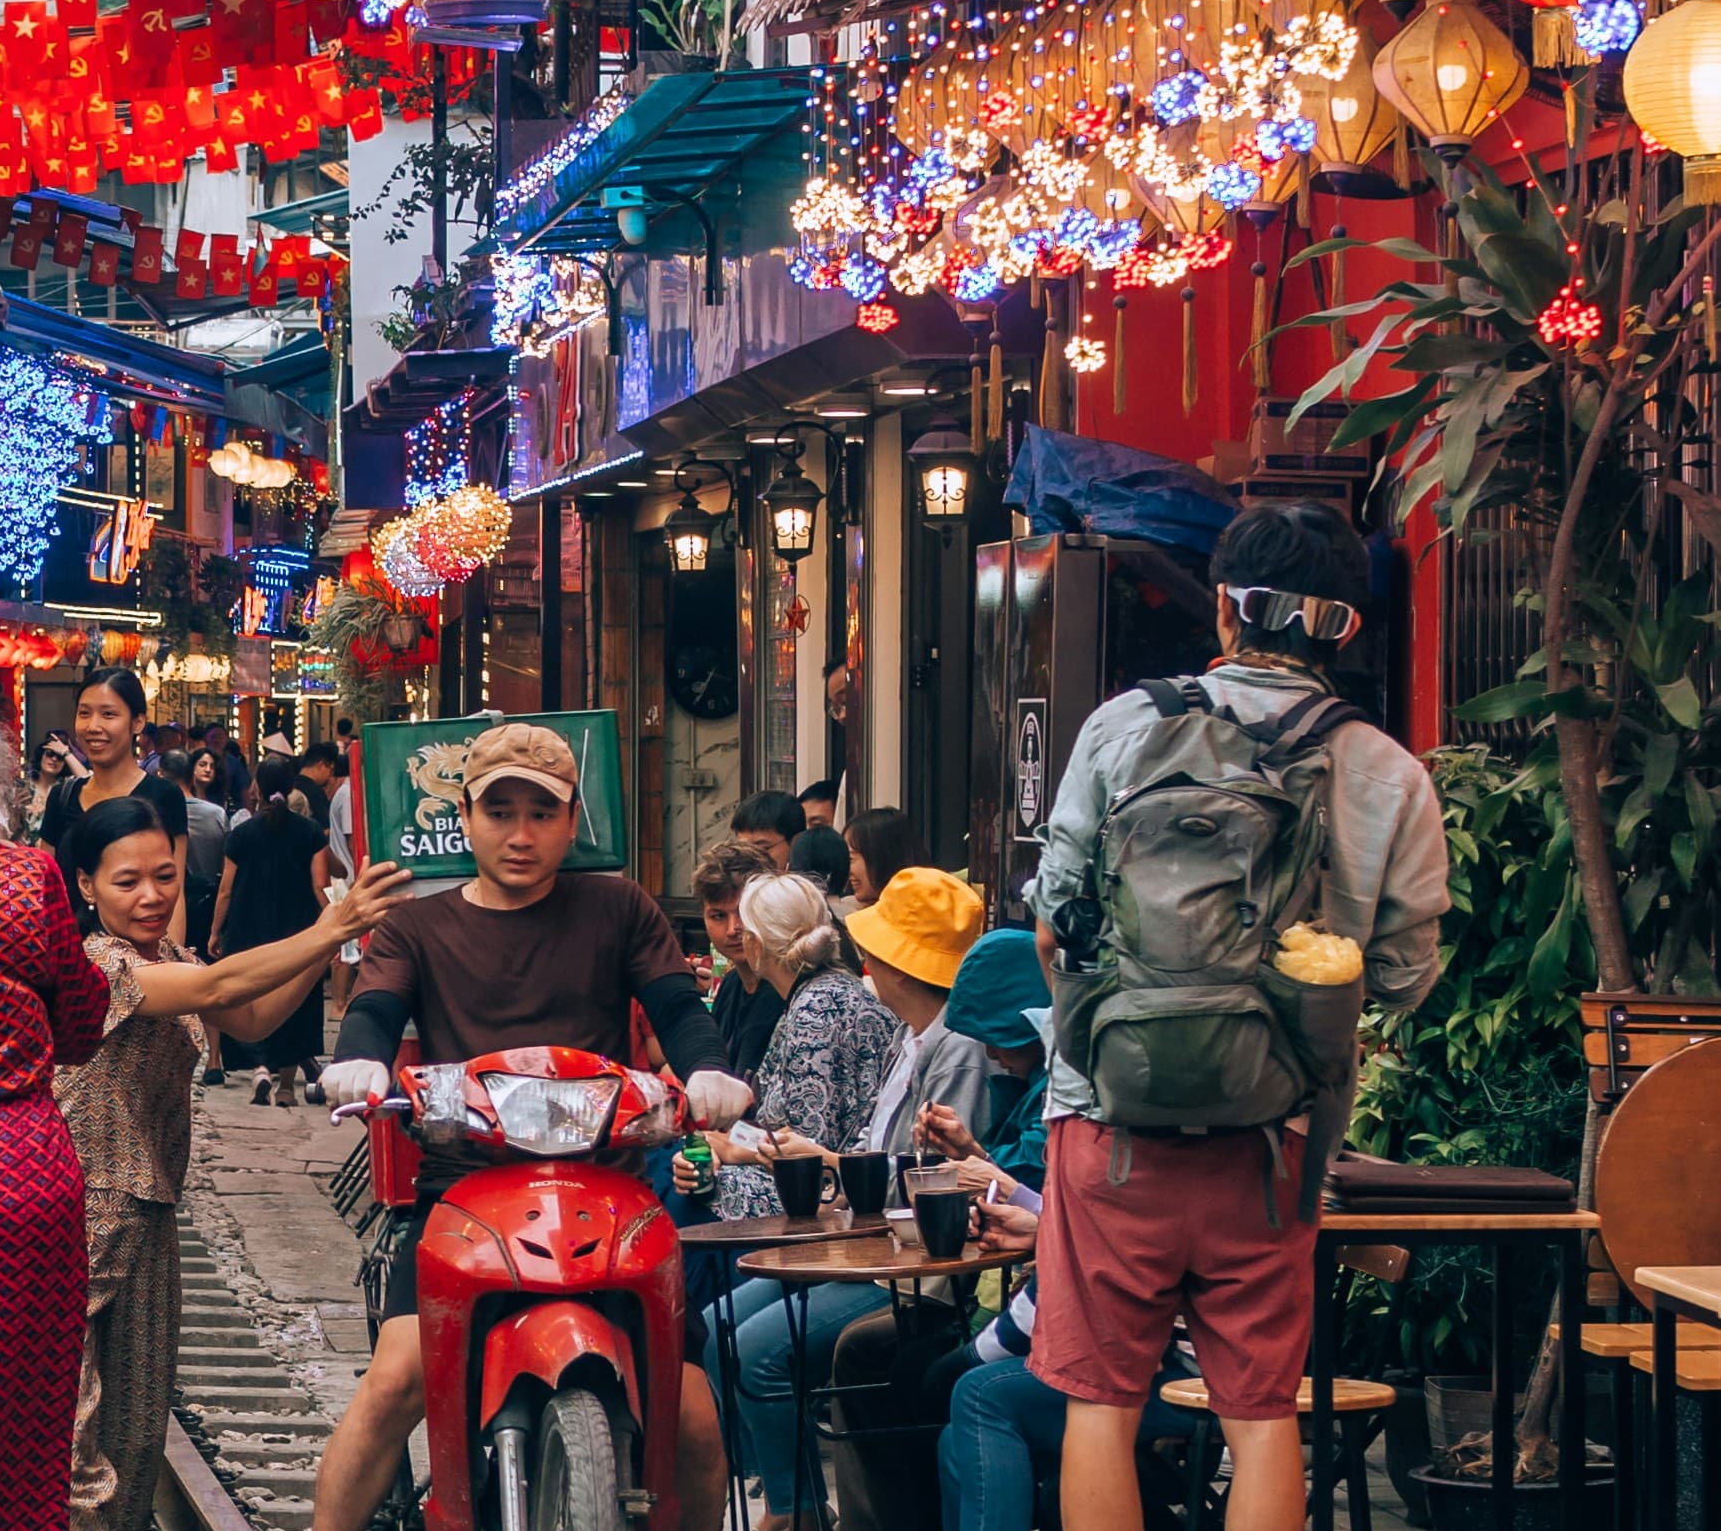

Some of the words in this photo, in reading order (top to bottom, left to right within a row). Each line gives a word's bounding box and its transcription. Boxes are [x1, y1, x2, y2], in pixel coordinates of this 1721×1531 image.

[435, 817, 464, 831] BIA
[400, 832, 474, 857] SAIG
[528, 1180, 587, 1189] HONDA
